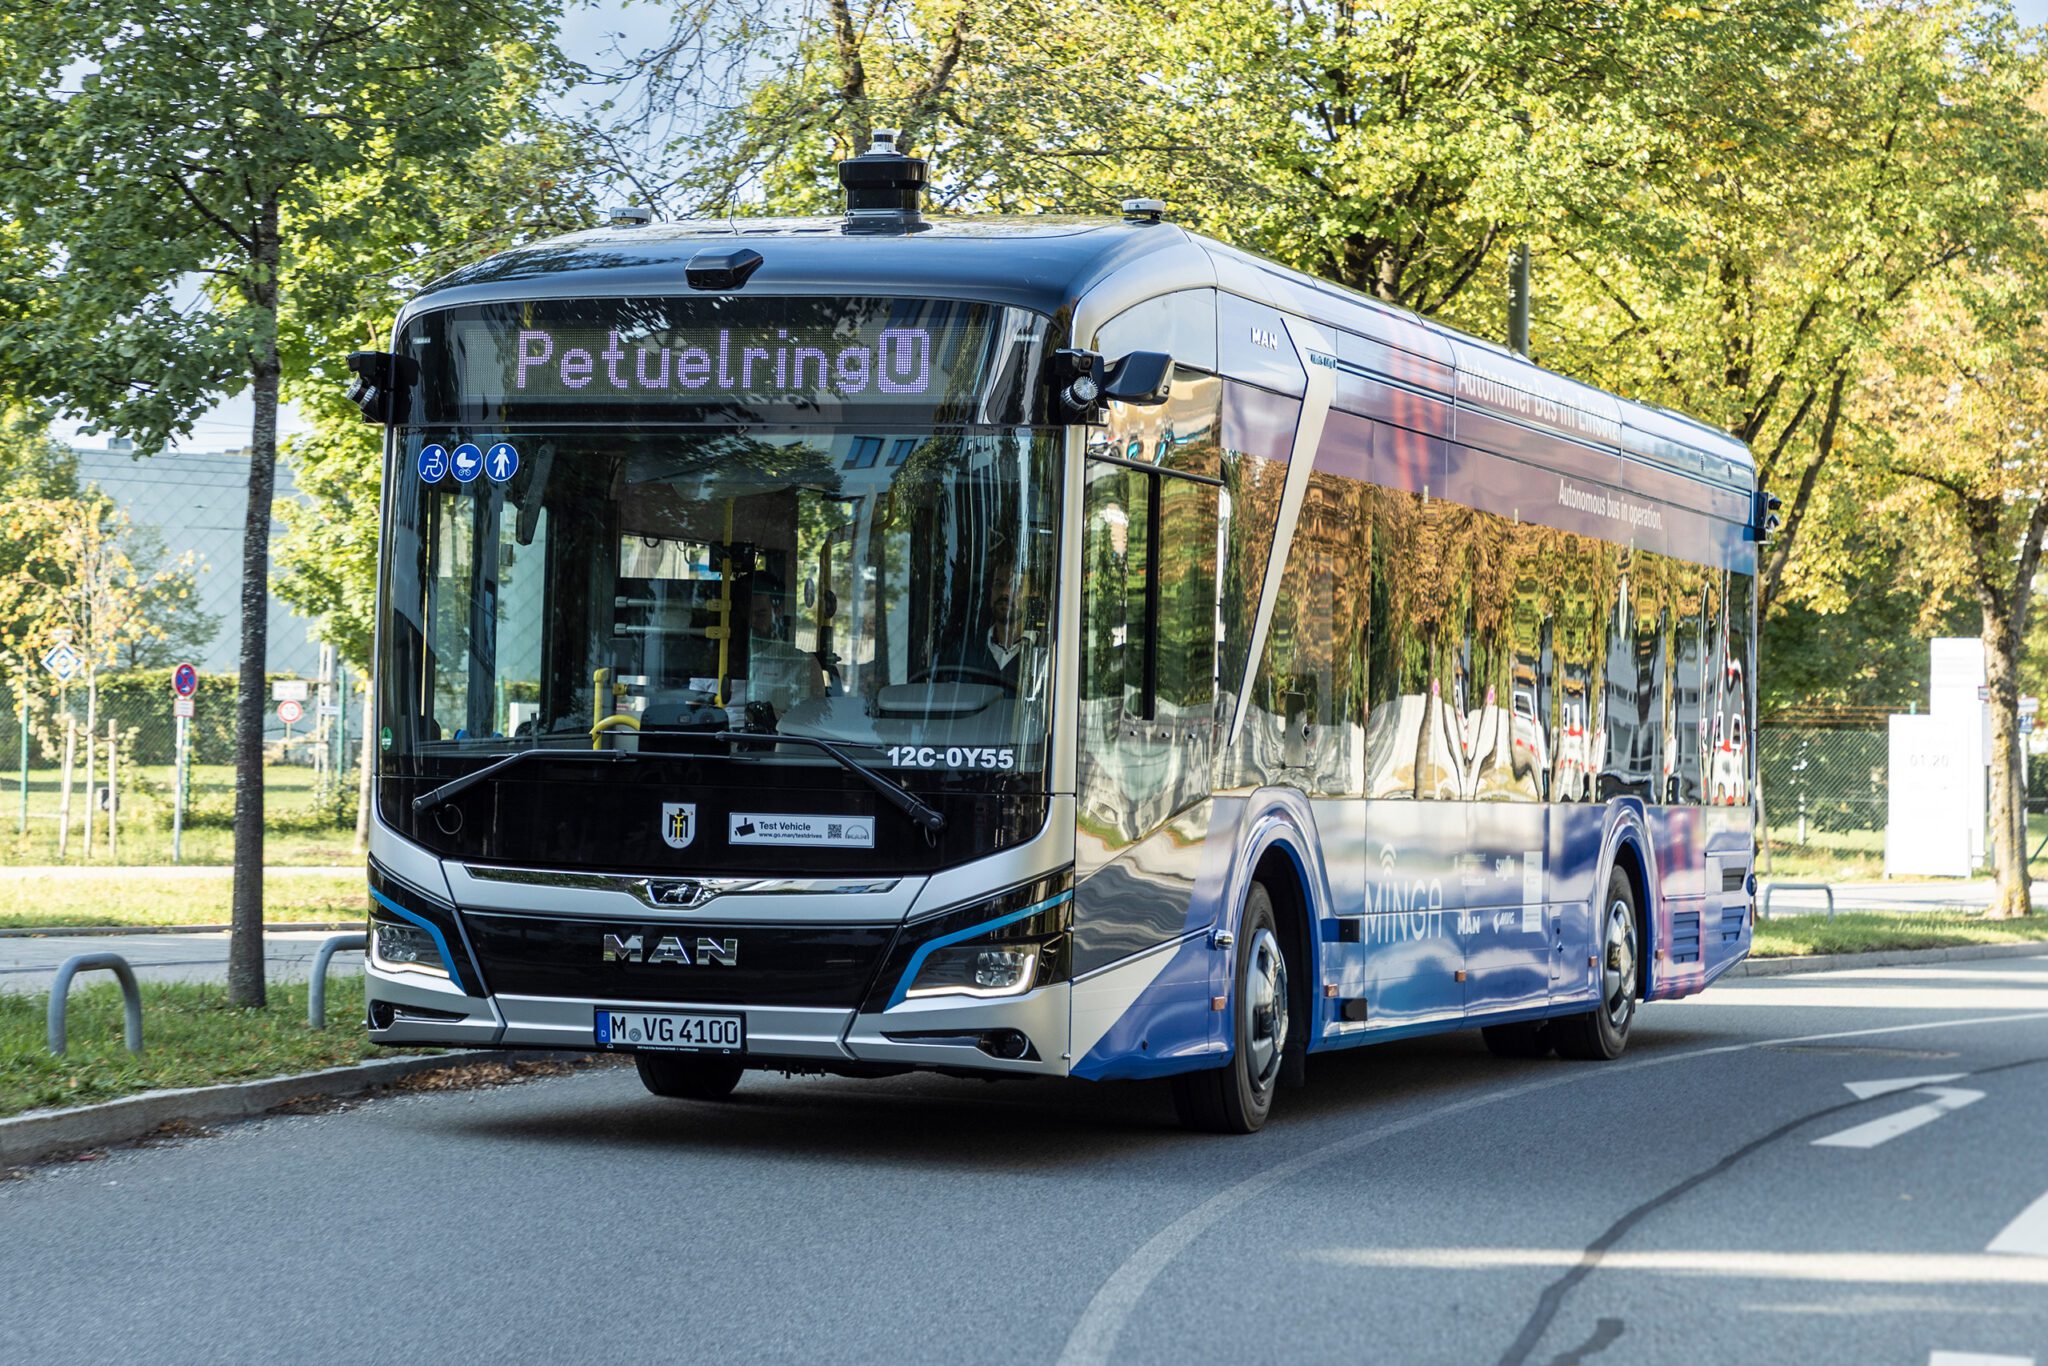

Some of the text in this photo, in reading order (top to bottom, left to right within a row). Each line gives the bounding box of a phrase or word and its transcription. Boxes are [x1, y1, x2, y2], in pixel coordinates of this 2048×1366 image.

[1251, 327, 1278, 350] MAN
[517, 329, 870, 393] Petuelring
[1457, 351, 1531, 414] Autonomer
[1533, 376, 1558, 423] Bus
[1558, 478, 1663, 530] Autonomous bus in operation.
[887, 746, 1014, 769] 12C-0Y55
[759, 821, 811, 831] Test Vehicle
[1364, 878, 1442, 945] MINGA
[1457, 915, 1481, 935] MAN
[603, 933, 738, 966] MAN
[611, 1016, 626, 1040] M
[643, 1017, 674, 1042] VG
[679, 1019, 738, 1044] 4100
